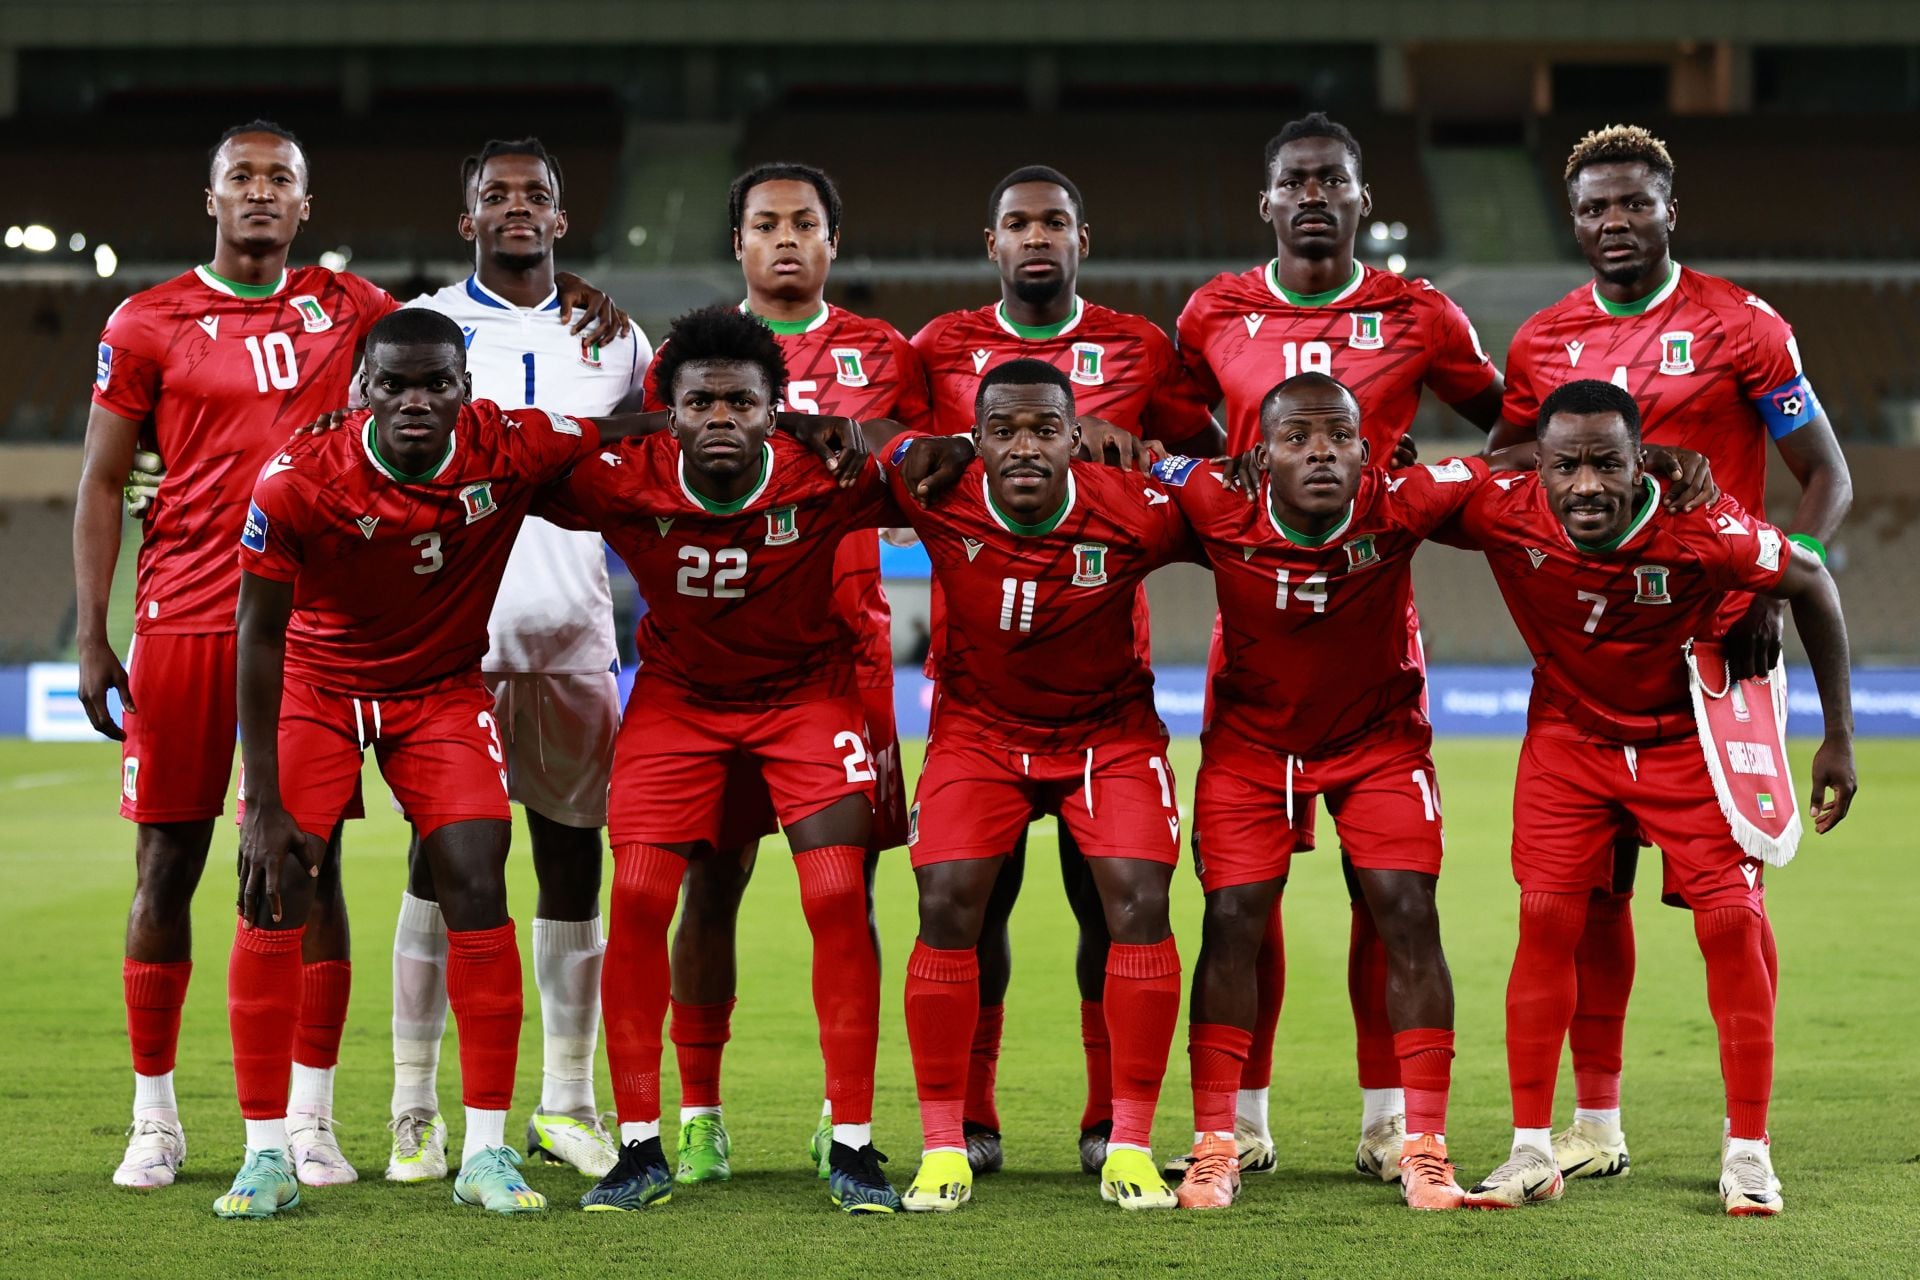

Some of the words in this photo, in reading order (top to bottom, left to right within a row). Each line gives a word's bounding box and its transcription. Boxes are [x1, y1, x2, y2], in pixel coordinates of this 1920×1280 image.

[244, 332, 299, 392] 10
[522, 352, 535, 405] 1
[776, 380, 819, 415] 5
[410, 531, 444, 575] 3
[676, 545, 748, 598] 22
[999, 577, 1037, 633] 11
[1275, 568, 1328, 613] 14
[1576, 590, 1608, 633] 7
[477, 711, 503, 763] 3
